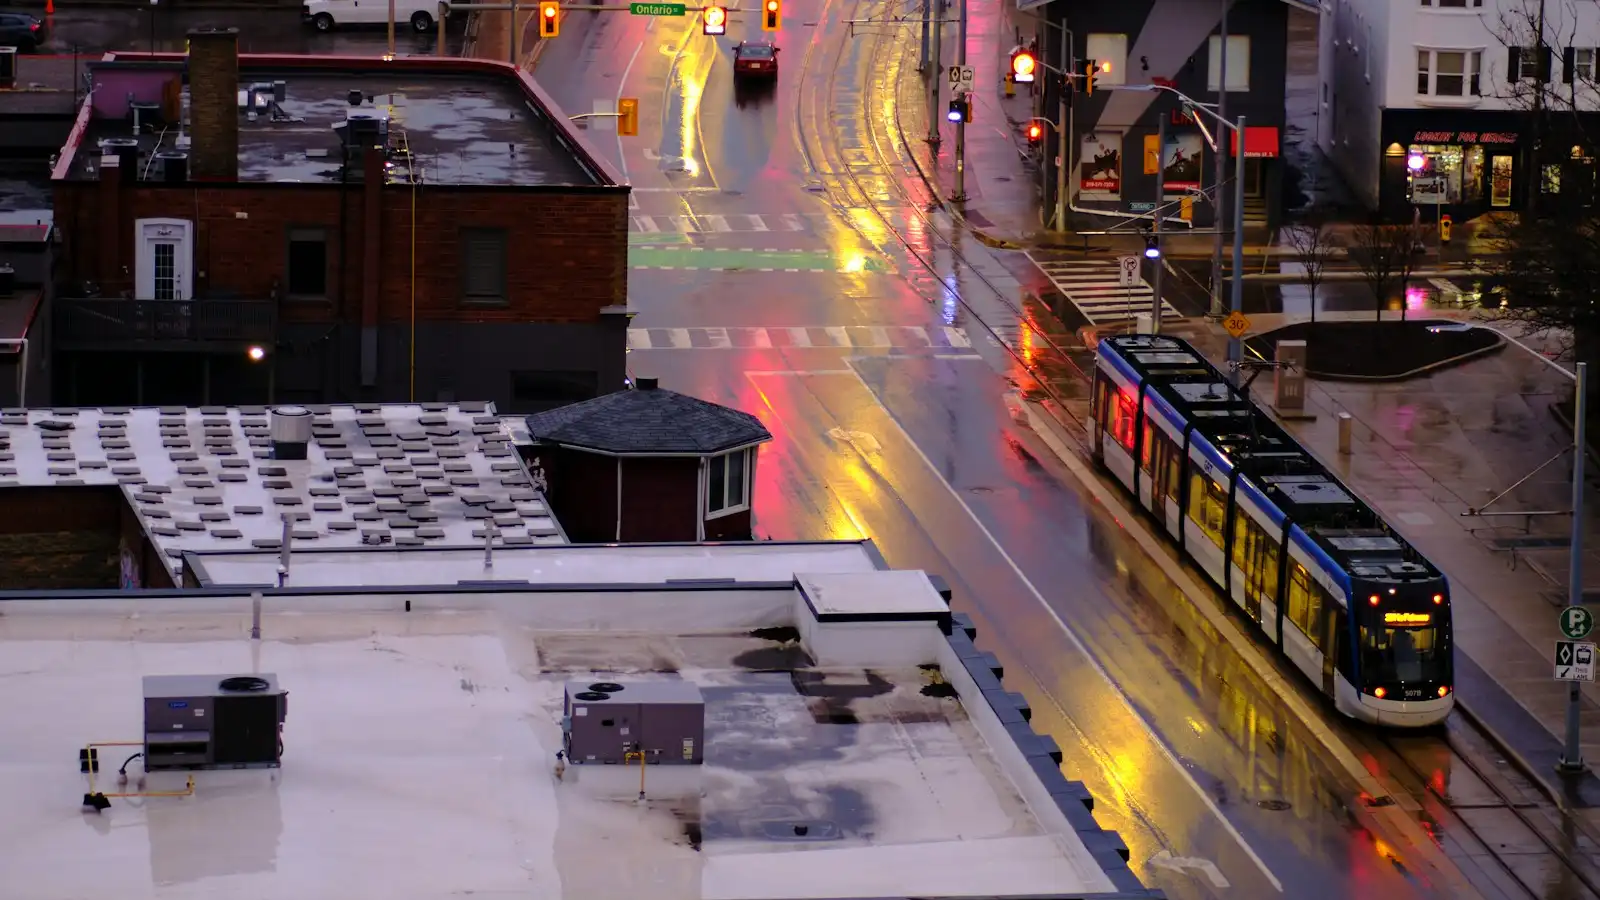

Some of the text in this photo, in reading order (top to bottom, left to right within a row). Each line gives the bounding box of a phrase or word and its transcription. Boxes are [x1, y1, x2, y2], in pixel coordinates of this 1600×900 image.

[636, 4, 673, 15] Ontario
[1457, 131, 1478, 143] FOR
[1228, 318, 1244, 331] 30
